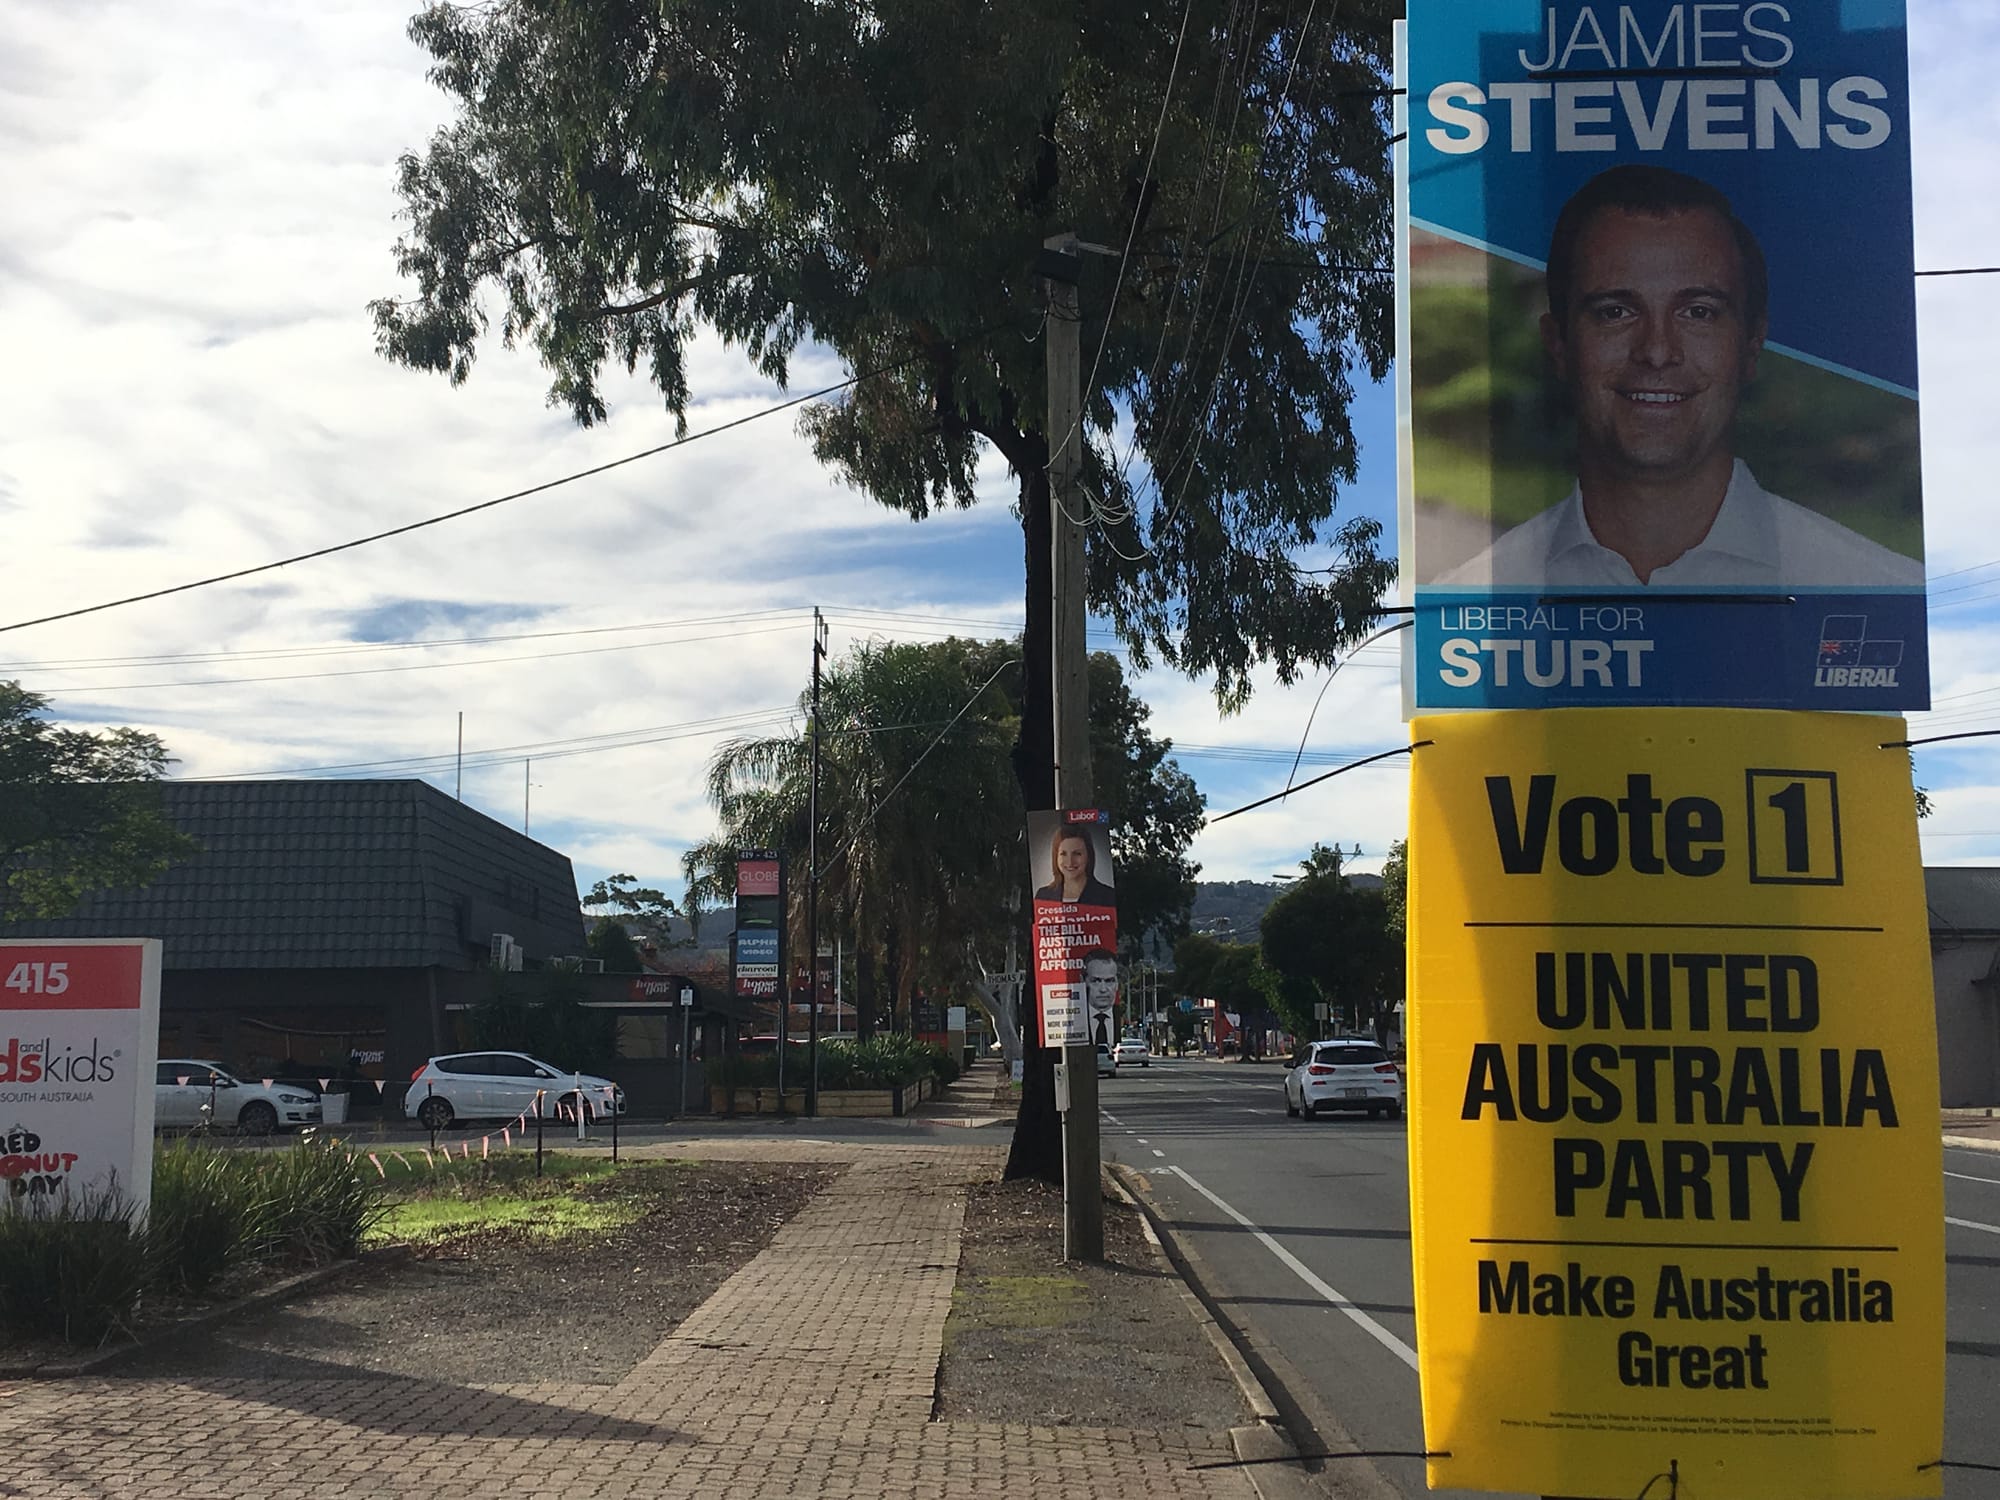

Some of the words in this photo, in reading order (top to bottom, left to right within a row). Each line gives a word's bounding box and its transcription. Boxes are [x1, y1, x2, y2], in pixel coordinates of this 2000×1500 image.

[1517, 3, 1794, 71] JAMES
[1426, 76, 1891, 154] STEVENS
[1441, 607, 1571, 632] LIBERAL
[1580, 607, 1644, 632] FOR
[1439, 638, 1655, 688] STURT
[1814, 667, 1899, 688] LIBERAL
[1070, 812, 1096, 821] Labor
[1485, 773, 1725, 876] Vote
[1769, 782, 1810, 873] 1
[738, 870, 779, 882] GLOBE
[1038, 905, 1078, 915] Cressida
[1039, 925, 1060, 937] THE
[1061, 924, 1085, 936] BILL
[1039, 935, 1102, 948] AUSTRALIA
[1039, 948, 1072, 960] CAN'T
[1040, 959, 1087, 971] AFFORD.
[5, 962, 69, 994] 415
[1536, 952, 1820, 1033] UNITED
[20, 1039, 44, 1053] and
[0, 1092, 37, 1103] SOUTH
[40, 1090, 95, 1103] AUSTRALIA
[1461, 1043, 1899, 1128] AUSTRALIA
[1553, 1137, 1816, 1222] PARTY
[1478, 1260, 1635, 1317] Make
[1653, 1264, 1894, 1323] Australia
[1617, 1331, 1769, 1390] Great
